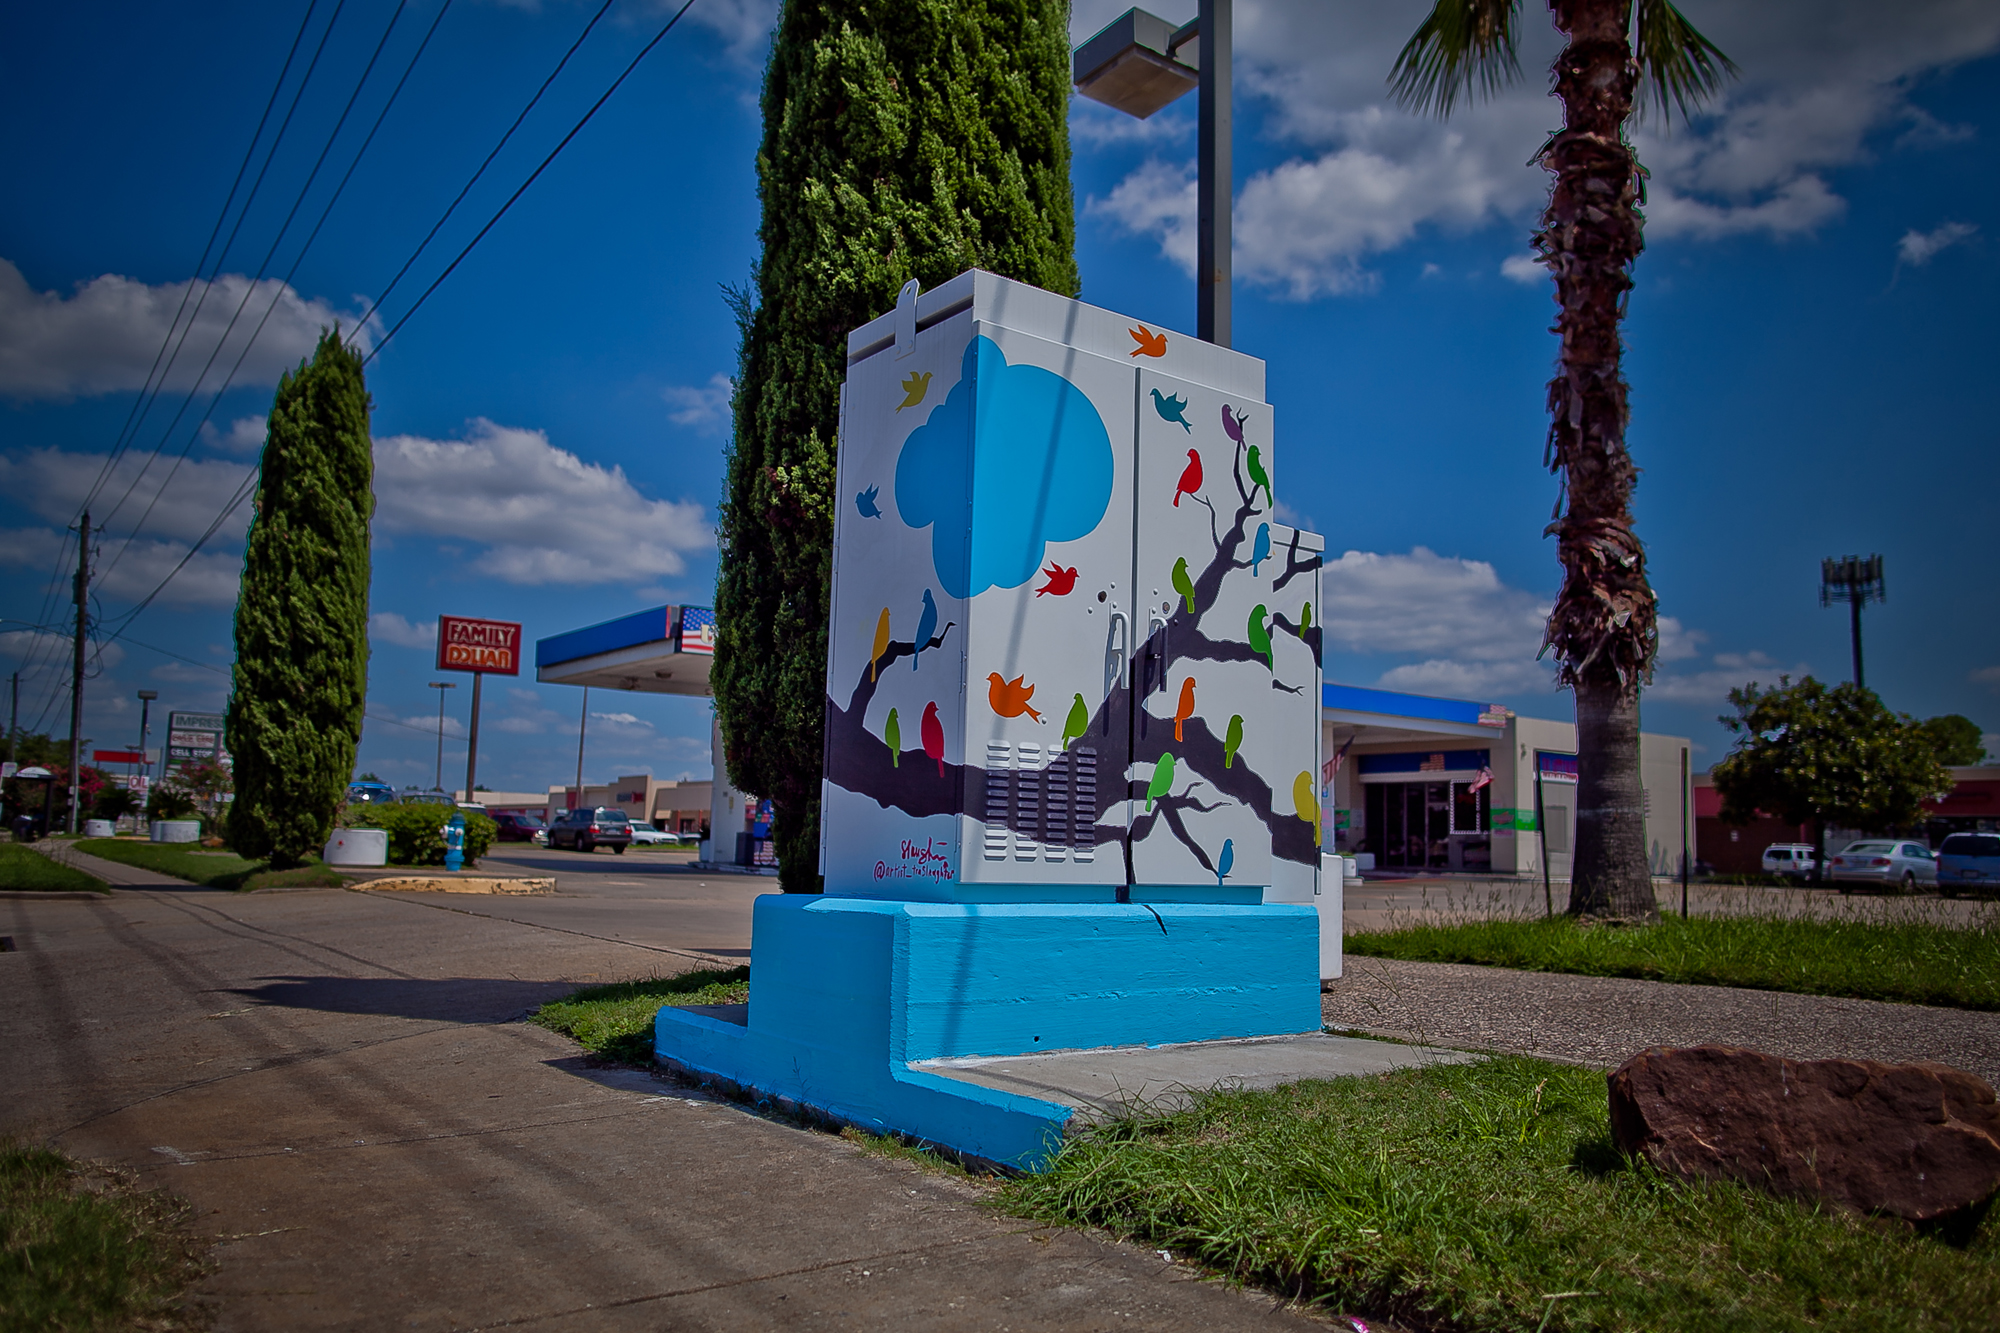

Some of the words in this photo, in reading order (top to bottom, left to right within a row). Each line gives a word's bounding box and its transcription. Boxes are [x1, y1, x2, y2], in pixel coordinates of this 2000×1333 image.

[447, 620, 516, 647] FAMILY
[446, 643, 512, 669] DOLLAR
[171, 747, 191, 757] CELL
